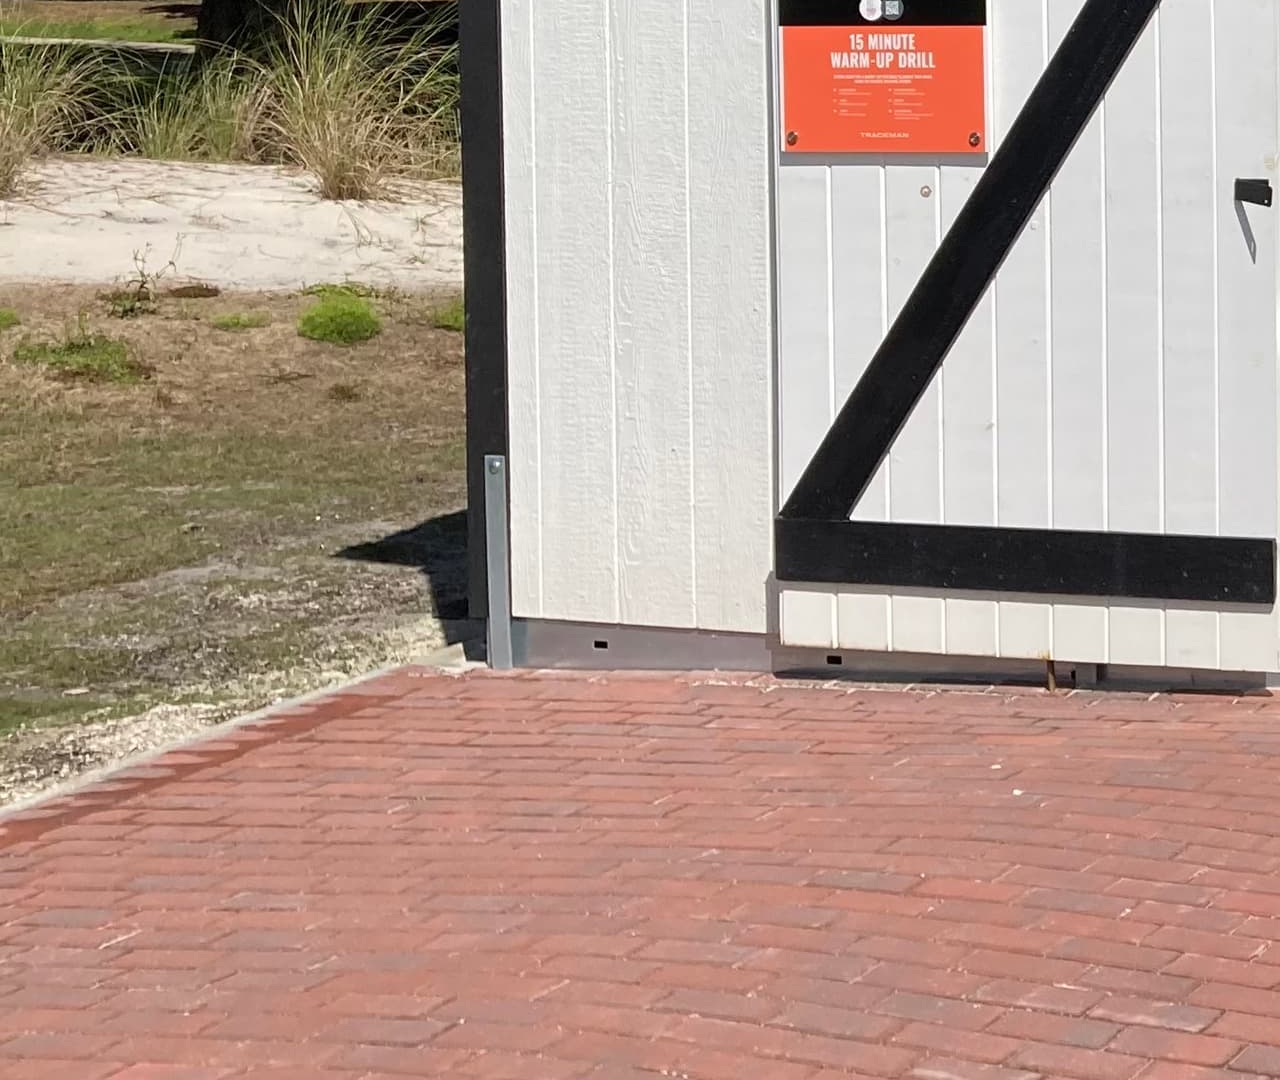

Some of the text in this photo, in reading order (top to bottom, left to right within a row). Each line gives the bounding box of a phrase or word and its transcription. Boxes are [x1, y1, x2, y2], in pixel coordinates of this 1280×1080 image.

[849, 33, 916, 50] 15 MINUTE
[830, 52, 936, 69] WARM-UP DRILL
